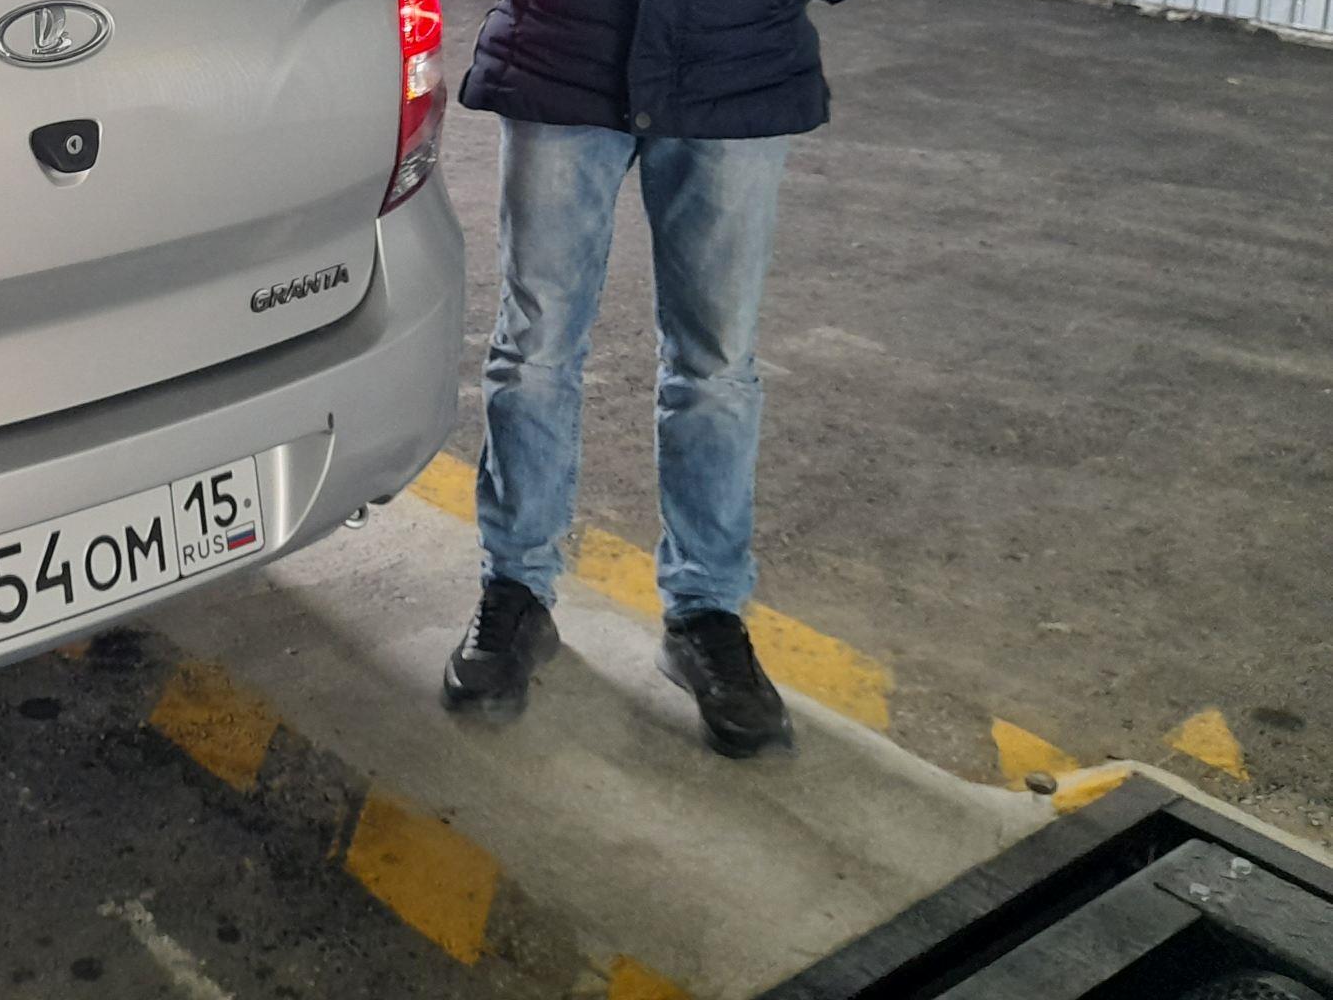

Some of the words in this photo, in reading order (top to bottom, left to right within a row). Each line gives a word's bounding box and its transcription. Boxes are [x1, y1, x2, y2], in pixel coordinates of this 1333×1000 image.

[250, 262, 349, 313] GRANTA
[183, 471, 238, 535] 15
[182, 533, 226, 567] RUS
